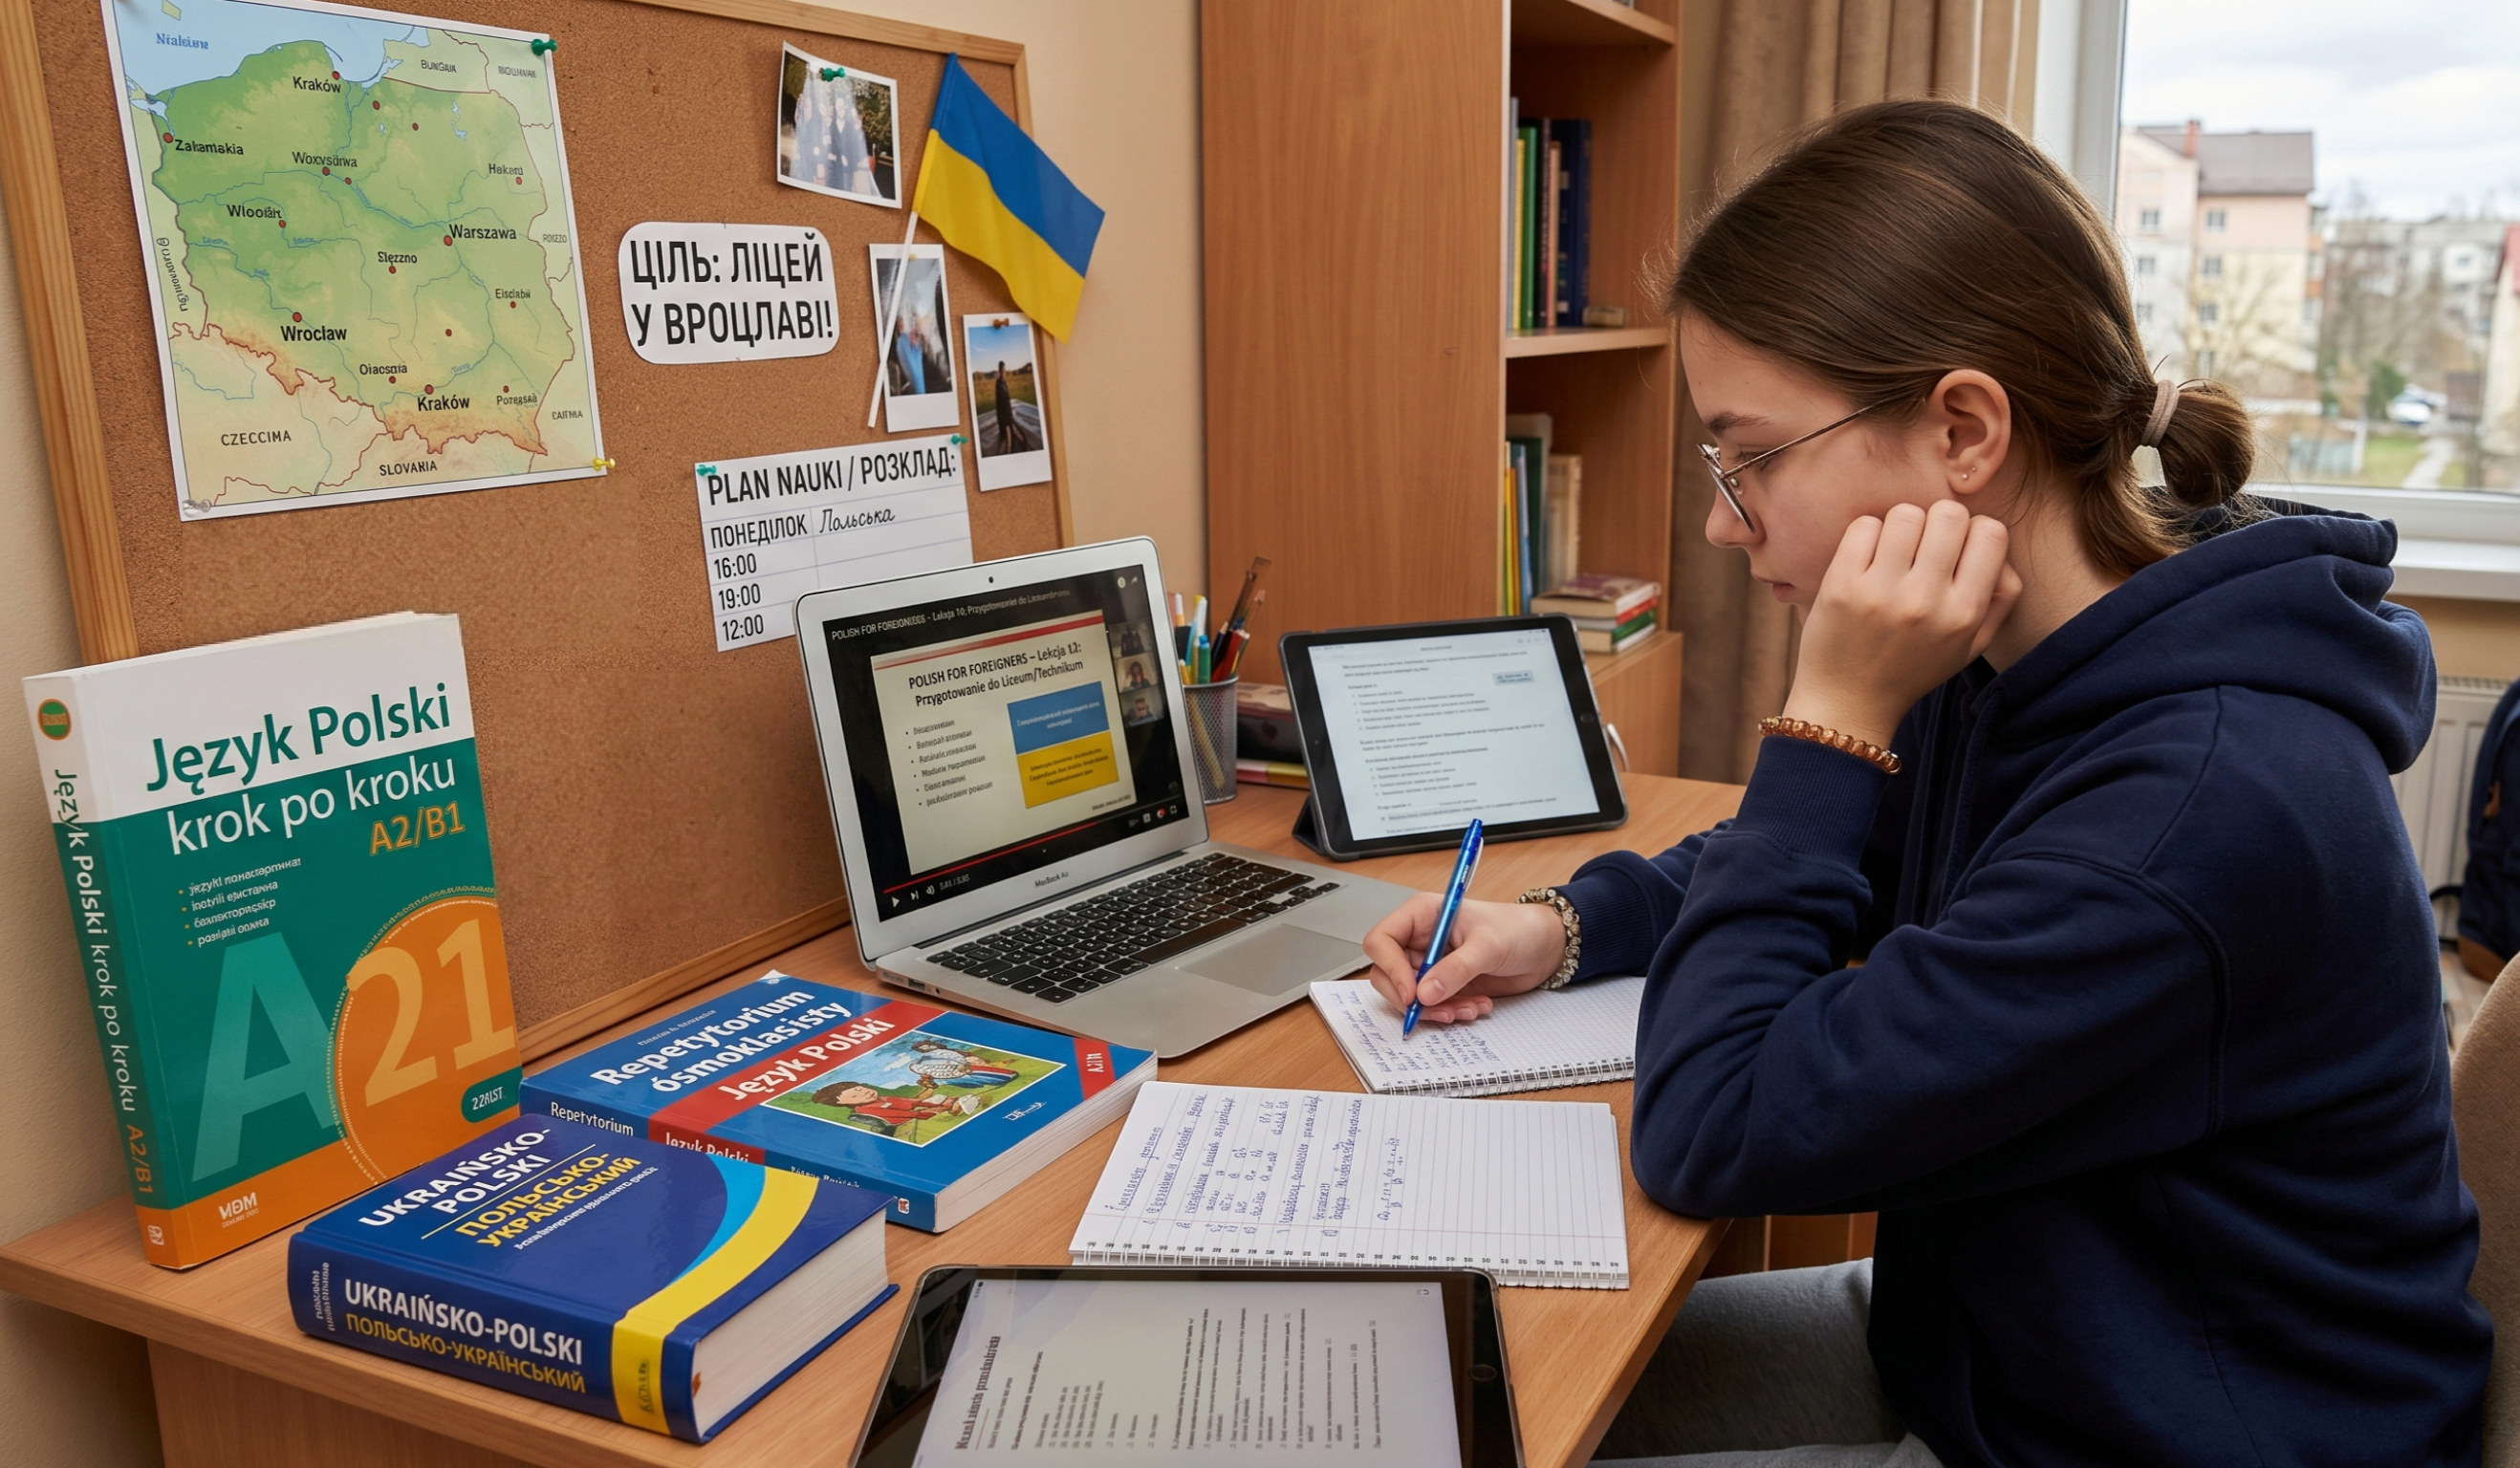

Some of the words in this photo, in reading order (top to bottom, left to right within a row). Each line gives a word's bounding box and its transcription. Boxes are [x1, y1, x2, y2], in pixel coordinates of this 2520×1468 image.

[293, 76, 341, 93] Kraków
[449, 224, 516, 240] Warszawa
[630, 240, 721, 290] ЦІЛЬ:
[731, 231, 823, 289] ЛІЦЕЙ
[631, 303, 652, 347] У
[663, 300, 834, 348] ВРОЦЛАВІ!
[418, 394, 470, 412] Kraków
[707, 468, 771, 506] PLAN
[776, 460, 842, 496] NAUKI
[860, 446, 956, 485] РОЗКЛАД:
[711, 514, 808, 549] ПОНЕДІЛОК
[714, 553, 757, 579] 16:00
[718, 583, 762, 611] 19:00
[722, 615, 765, 642] 12:00
[861, 623, 878, 635] FOR
[909, 671, 945, 689] POLISH
[947, 666, 967, 681] FOR
[969, 653, 1028, 675] FOREIGNERS
[1037, 645, 1066, 662] Lekcja
[915, 681, 986, 707] Przygotowanie
[988, 679, 1000, 691] do
[1001, 660, 1083, 688] Liceum/Technikum
[146, 713, 299, 796] Język
[308, 682, 451, 755] Polski
[54, 768, 90, 849] Język
[167, 793, 271, 855] krok
[280, 788, 335, 838] po
[345, 758, 457, 810] kroku
[369, 801, 466, 856] A2/B1
[72, 854, 108, 935] Polski
[90, 943, 117, 999] krok
[98, 1005, 120, 1036] po
[347, 918, 516, 1107] 21
[590, 991, 815, 1086] Repetytorium
[192, 931, 339, 1182] A
[652, 1002, 853, 1093] ósmoklasisty
[718, 1051, 816, 1101] Język
[812, 1018, 895, 1060] Polski
[110, 1044, 137, 1112] kroku
[551, 1101, 634, 1136] Repetytorium
[125, 1123, 154, 1195] A2/B1
[358, 1129, 551, 1226] UKRAIŃSKO-
[431, 1155, 552, 1215] POLSKI
[455, 1154, 609, 1237] ПОЛЬСЬКО-
[477, 1156, 641, 1247] УКРАЇНСЬКИЙ
[344, 1279, 582, 1365] UKRAIŃSKO-POLSKI
[346, 1312, 586, 1393] ПОЛЬСЬКО-УКРАЇНСЬКИЙ
